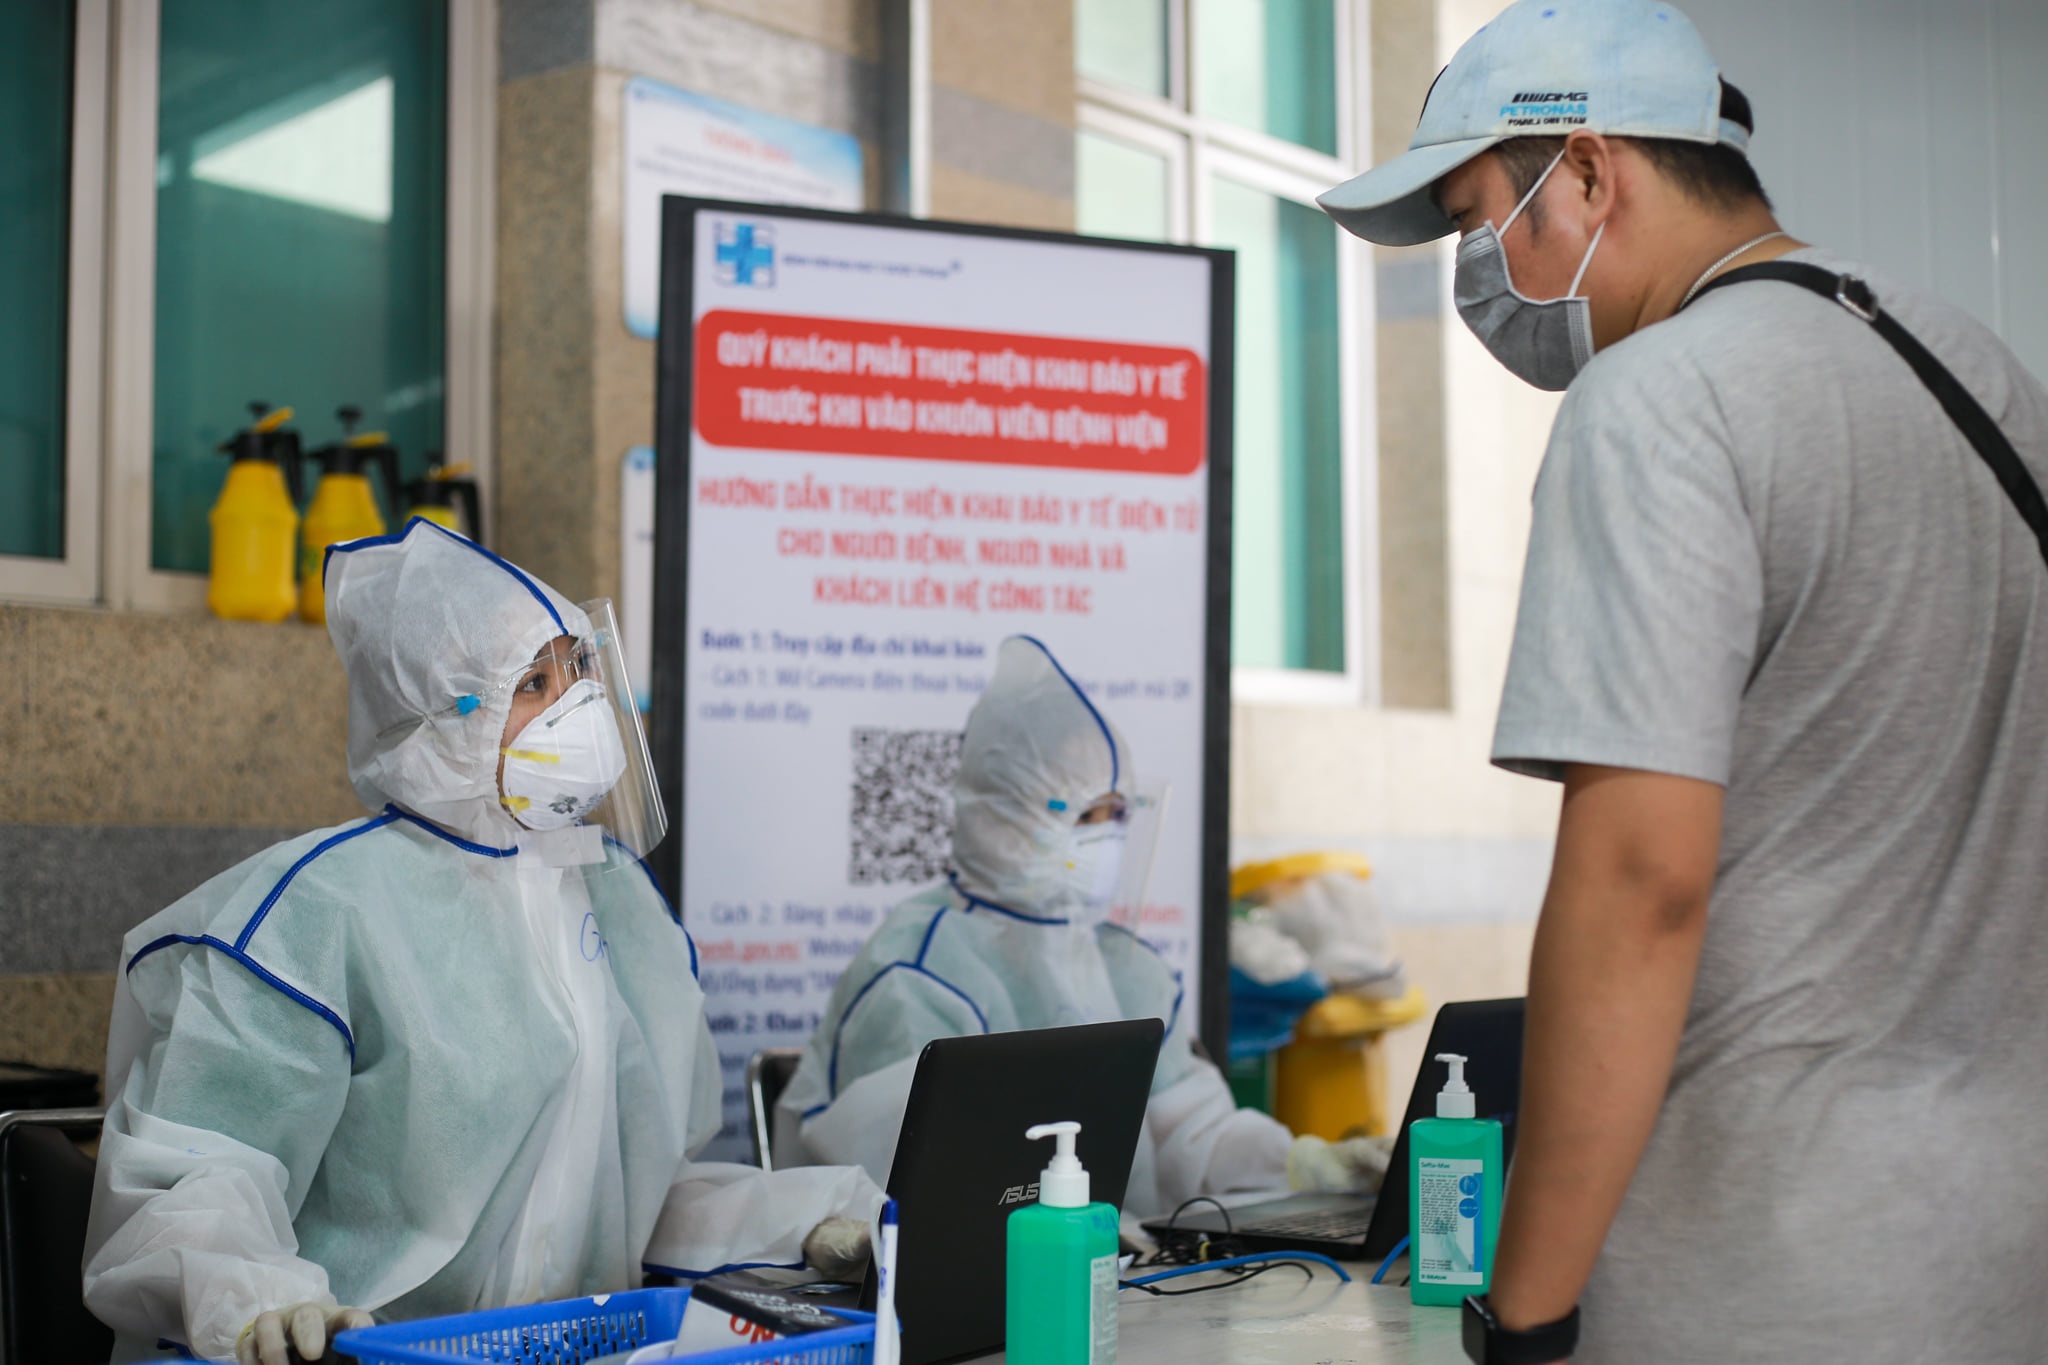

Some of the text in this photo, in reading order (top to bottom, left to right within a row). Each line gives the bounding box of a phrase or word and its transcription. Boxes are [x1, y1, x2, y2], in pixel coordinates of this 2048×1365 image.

[1500, 103, 1587, 117] PETRONAS
[716, 329, 768, 368] QUÝ
[770, 332, 854, 374] KHÁCH
[915, 346, 975, 388] THỰC
[977, 348, 1031, 391] HIỆN
[1034, 357, 1088, 392] KHAI
[1139, 365, 1157, 397] Y
[1159, 360, 1190, 400] TẾ
[739, 386, 1167, 454] TRƯỚC KHI VÀO KHUÔN VIÊN BỆNH VIỆN
[699, 476, 777, 509] HƯỚNG
[785, 472, 831, 511] DẪN
[903, 485, 955, 521] HIỆN
[961, 493, 1012, 523] KHAI
[1020, 490, 1062, 526] BÁO
[1069, 500, 1081, 527] Y
[1089, 492, 1115, 529] TẾ
[777, 529, 824, 557] CHO
[814, 572, 892, 606] KHÁCH
[899, 575, 948, 609] LIÊN
[988, 578, 1045, 614] CÔNG
[1052, 584, 1092, 616] TÁC
[998, 1182, 1040, 1205] ASUS
